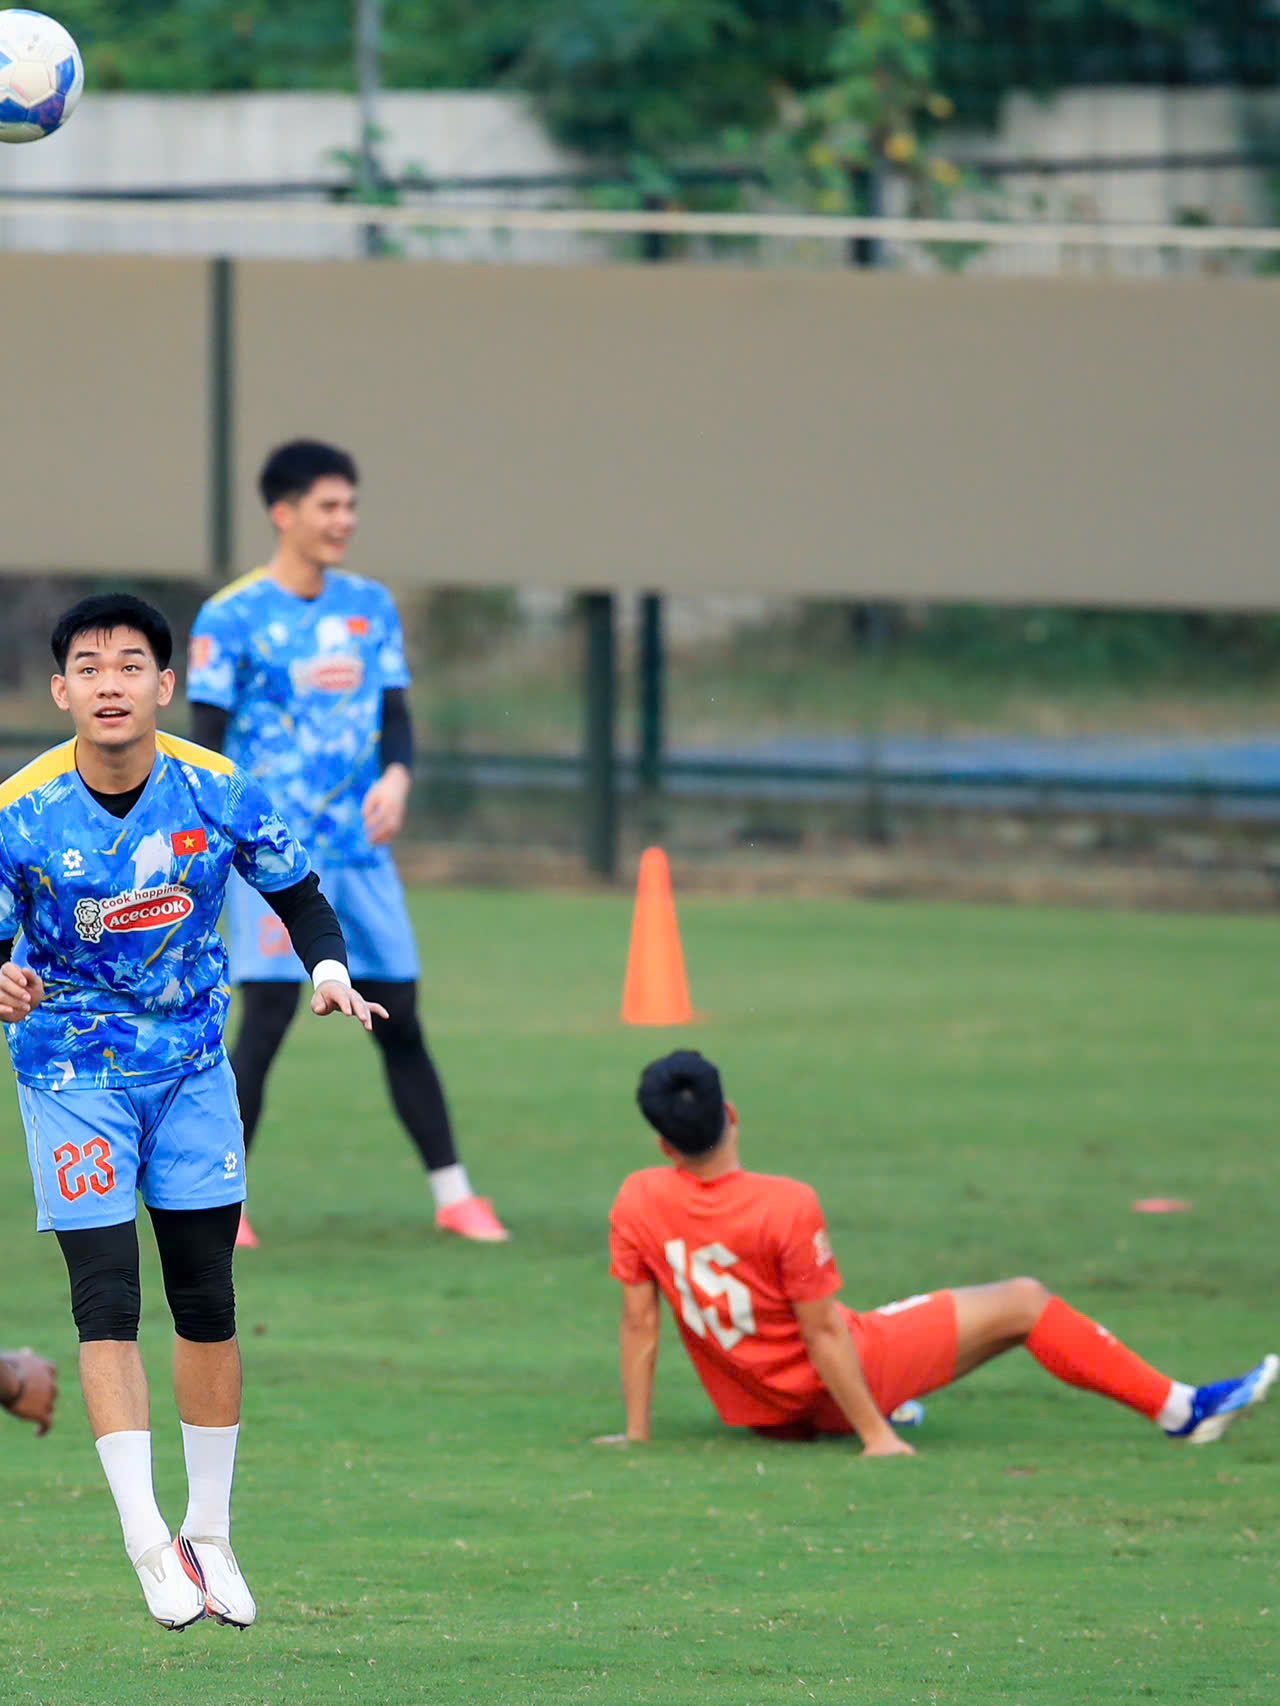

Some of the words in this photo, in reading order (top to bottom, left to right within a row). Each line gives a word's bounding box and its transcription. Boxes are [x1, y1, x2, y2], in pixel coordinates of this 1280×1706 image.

[101, 893, 132, 910] Cook
[53, 1136, 116, 1203] 23
[664, 1238, 756, 1350] 15
